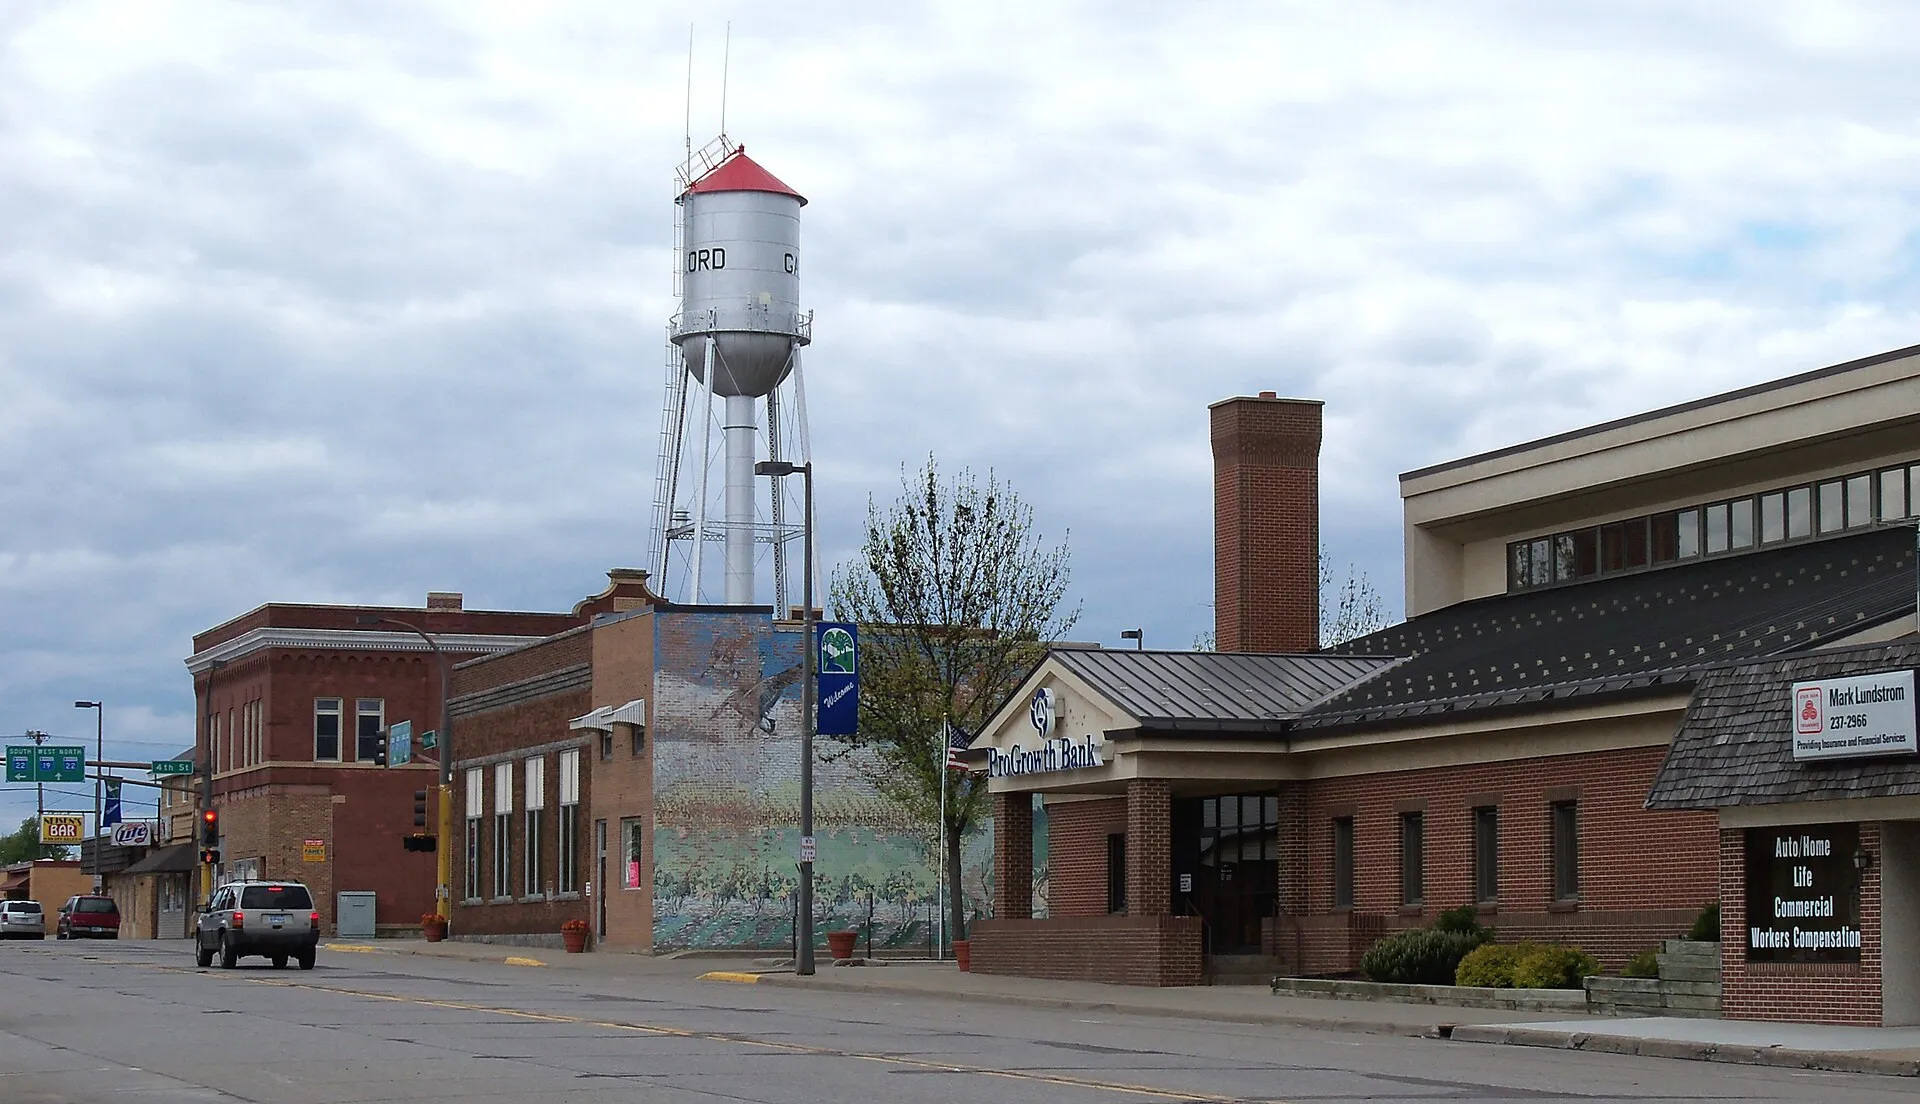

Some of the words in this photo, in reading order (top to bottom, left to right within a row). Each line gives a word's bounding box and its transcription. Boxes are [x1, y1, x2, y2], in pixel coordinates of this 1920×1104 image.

[686, 248, 726, 273] ORD
[823, 682, 855, 708] Welcome
[1829, 687, 1854, 707] Mark
[1855, 684, 1905, 704] Lundstrom
[1830, 713, 1867, 730] 237-2966
[1797, 739, 1821, 751] Providing
[1822, 738, 1847, 748] Insurance
[1847, 737, 1857, 747] and
[1858, 735, 1882, 746] Financial
[1882, 733, 1906, 744] Services
[156, 763, 174, 771] 4th
[178, 763, 189, 771] St
[987, 740, 1058, 778] ProGrowth
[1061, 734, 1096, 769] Bank
[50, 824, 75, 836] BAR
[119, 827, 147, 842] Lite
[1775, 835, 1831, 858] Auto/Home
[1793, 866, 1813, 887] Life
[1774, 895, 1834, 918] Commercial
[1751, 926, 1790, 948] Workers
[1793, 925, 1861, 951] Compensation
